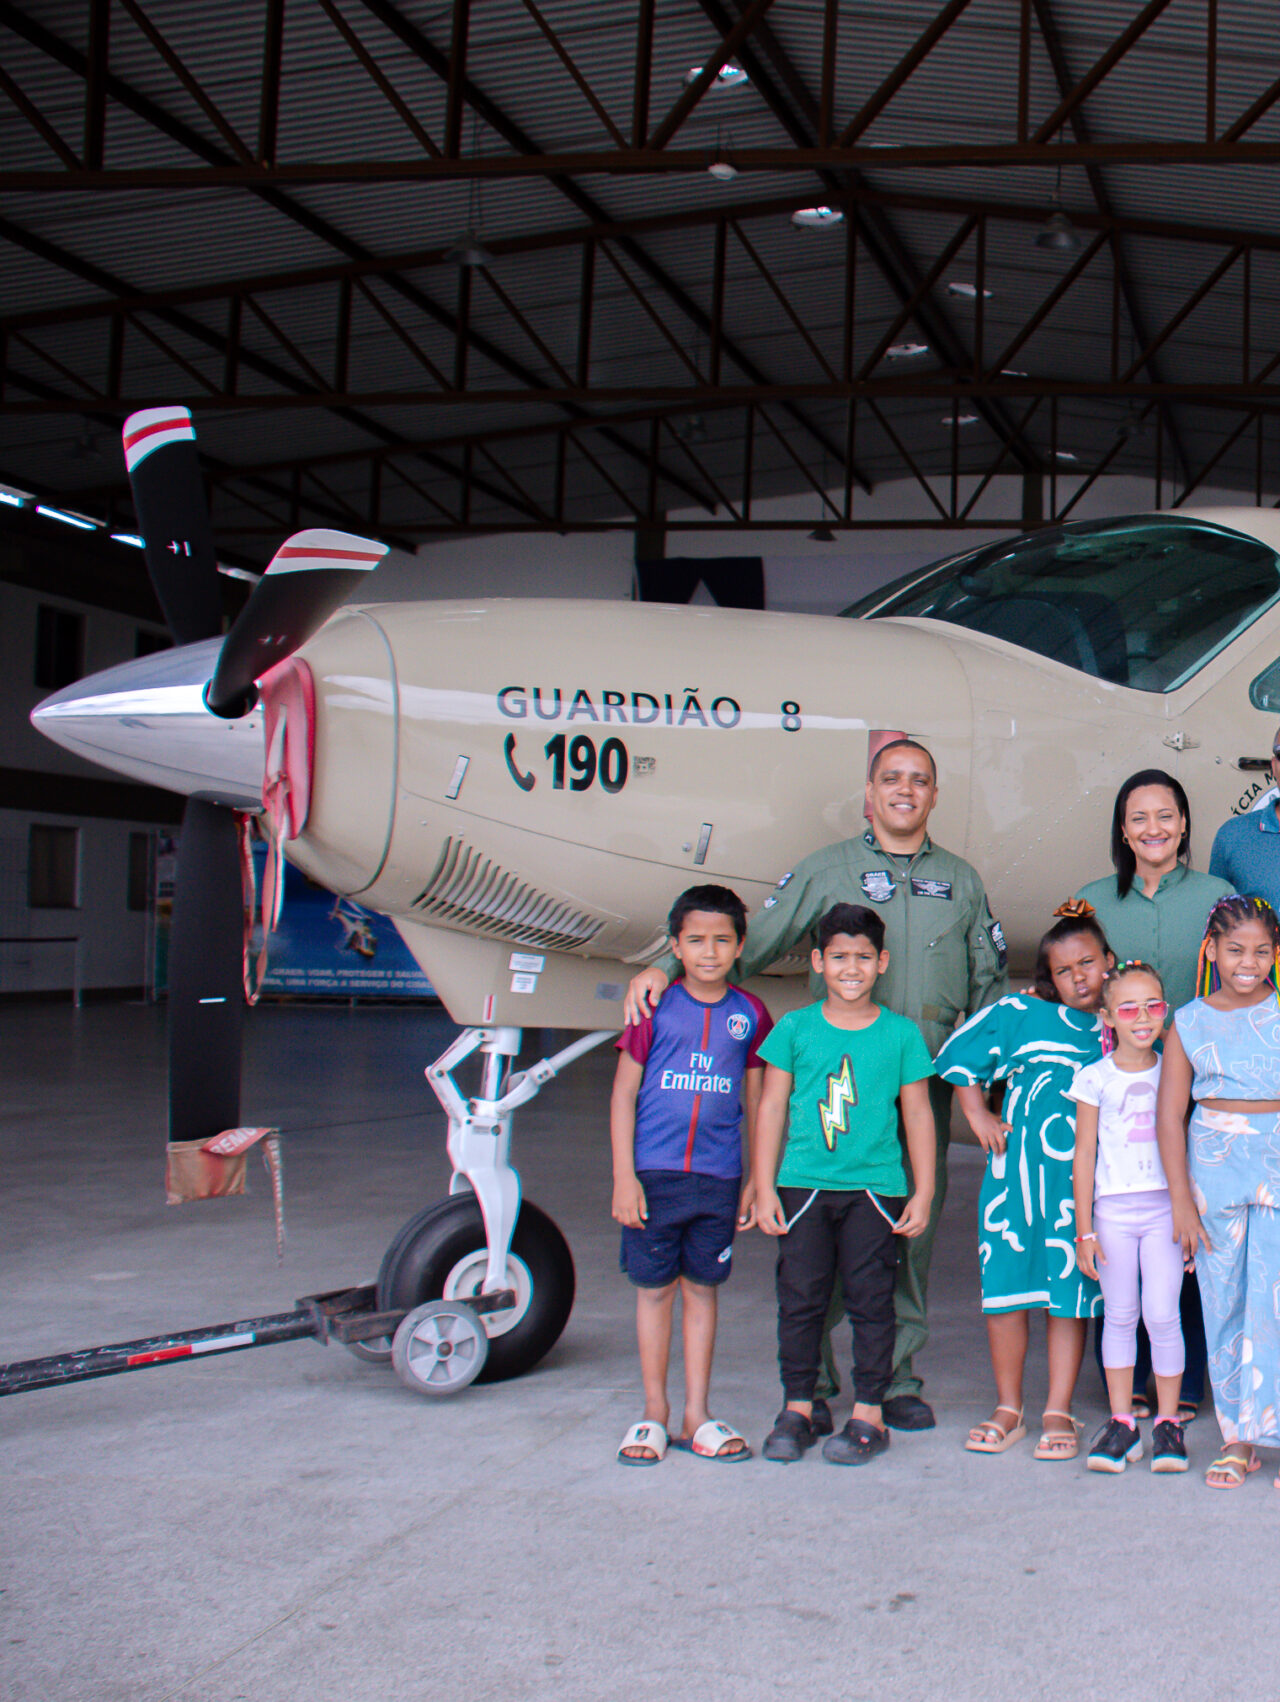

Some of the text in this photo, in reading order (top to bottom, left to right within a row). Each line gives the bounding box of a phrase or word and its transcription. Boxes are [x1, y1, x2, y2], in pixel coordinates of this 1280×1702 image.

[497, 686, 802, 732] GUARDIÃO 8
[544, 733, 629, 794] 190
[689, 1052, 714, 1072] Fly
[660, 1069, 732, 1094] Emirates
